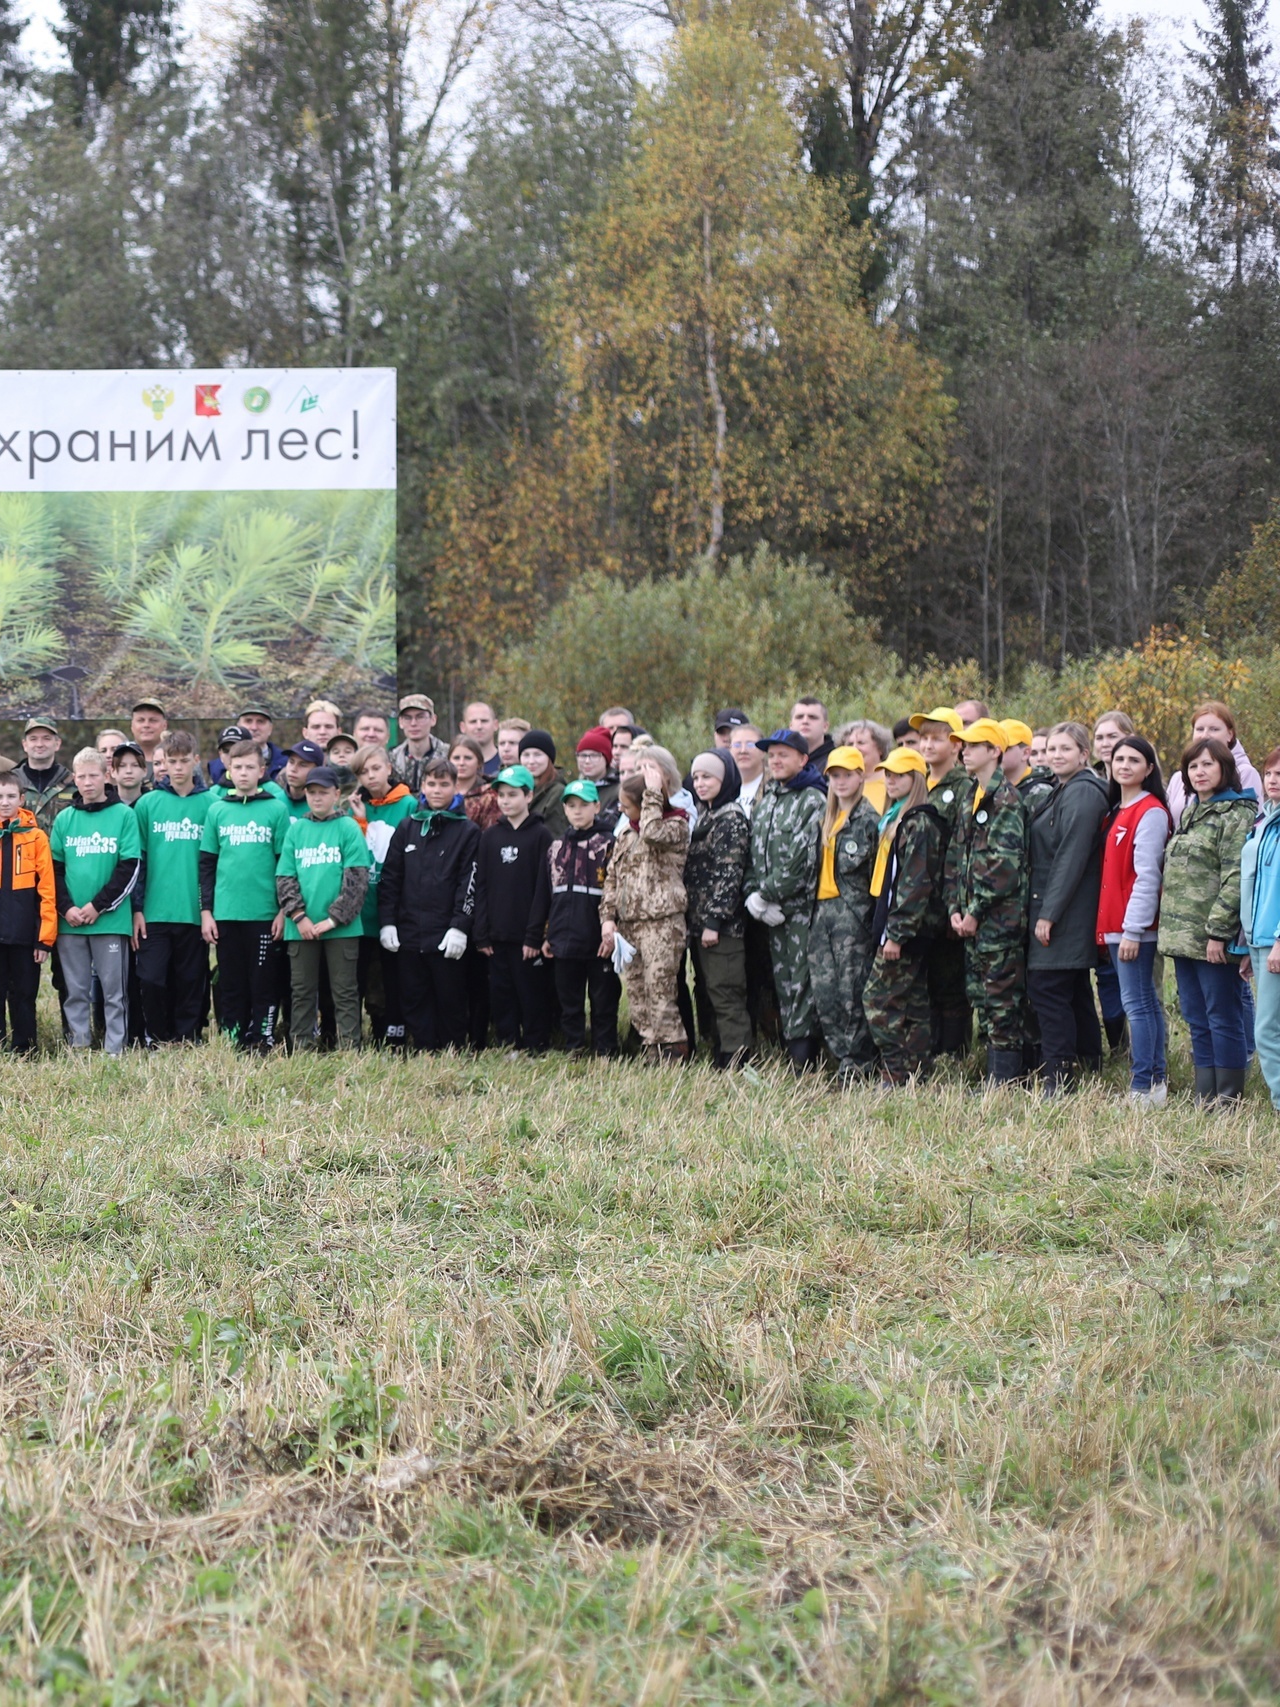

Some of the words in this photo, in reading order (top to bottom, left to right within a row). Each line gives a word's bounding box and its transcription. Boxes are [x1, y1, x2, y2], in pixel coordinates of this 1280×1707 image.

[240, 409, 360, 461] лес!
[191, 823, 205, 841] 35
[258, 826, 272, 843] 35
[100, 837, 118, 854] 35
[326, 846, 342, 864] 35
